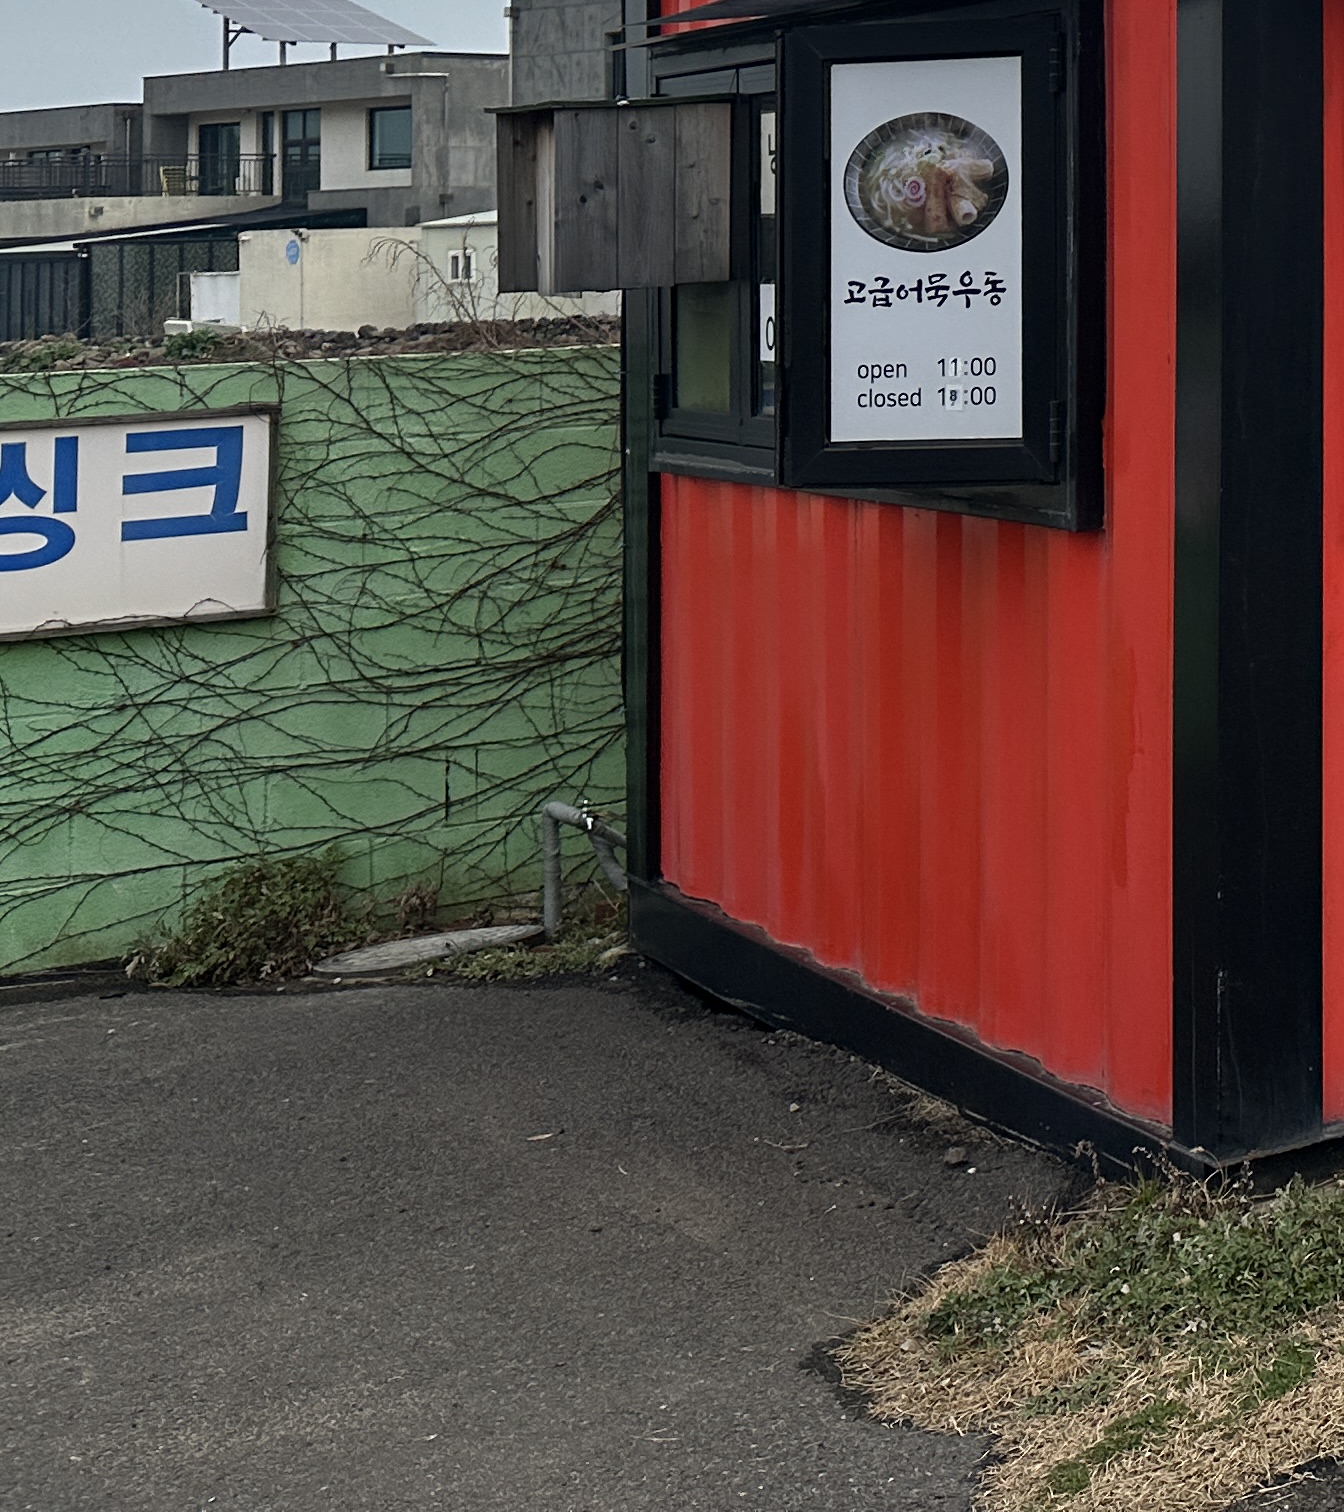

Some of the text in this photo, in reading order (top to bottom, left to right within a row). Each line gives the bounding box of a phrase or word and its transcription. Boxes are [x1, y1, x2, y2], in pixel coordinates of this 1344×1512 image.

[844, 270, 1007, 308] 고급어묵우동
[857, 357, 997, 384] open 11:00
[857, 387, 922, 408] closed
